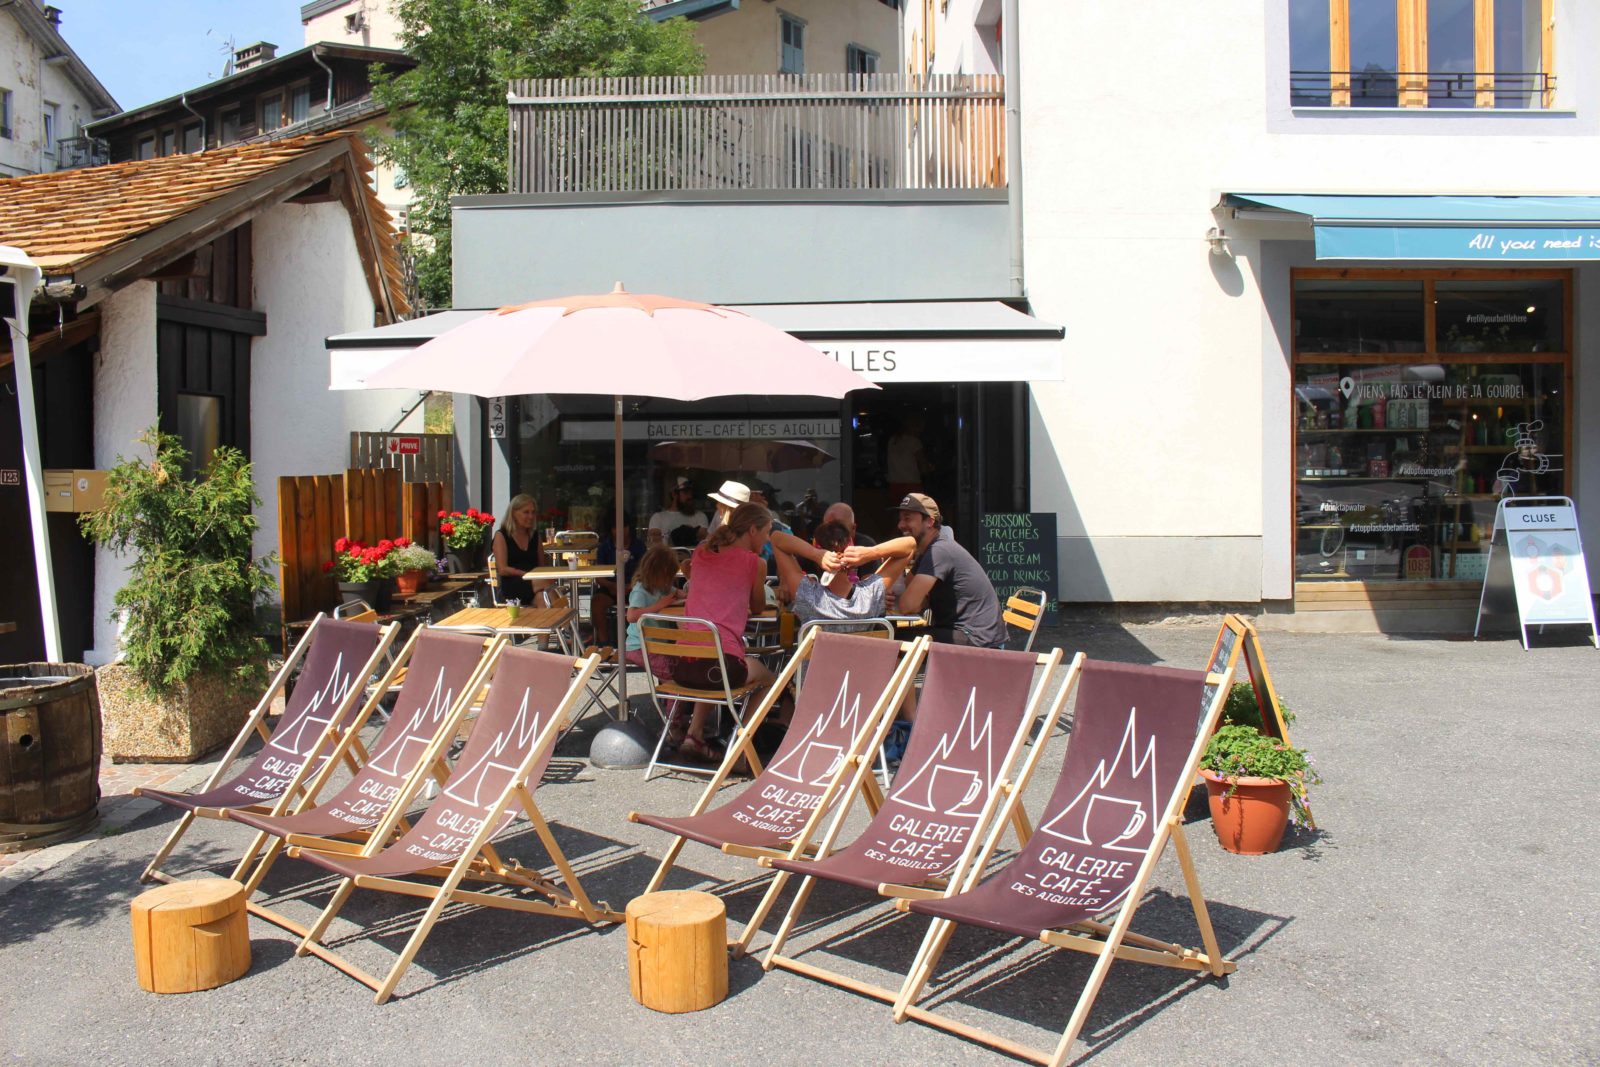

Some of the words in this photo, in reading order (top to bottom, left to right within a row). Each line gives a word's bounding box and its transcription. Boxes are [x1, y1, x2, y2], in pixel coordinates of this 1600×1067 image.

[1468, 233, 1496, 250] All
[1500, 239, 1536, 255] you
[1543, 235, 1583, 249] need
[1466, 314, 1528, 324] #refillyourbottlehere
[1390, 384, 1408, 399] FAIS
[1412, 384, 1424, 399] LE
[1427, 384, 1452, 399] PLEIN
[1456, 384, 1468, 399] DE
[1486, 384, 1525, 399] GOURDE!
[752, 423, 778, 437] DES
[782, 422, 842, 437] AIGUILL
[3, 471, 18, 483] 123
[1320, 502, 1366, 512] #drinktapwater
[984, 513, 1033, 528] BOISSONS
[1522, 513, 1557, 523] CLUSE
[985, 541, 1025, 554] GLACES
[986, 554, 1005, 565] ICE
[1007, 552, 1041, 565] CREAM
[1013, 569, 1051, 583] DRINKS
[261, 756, 302, 778] GALER
[358, 778, 401, 801] GALER
[761, 784, 822, 810] GALERIE
[436, 808, 483, 835] GALER
[732, 811, 752, 823] DES
[748, 820, 796, 833] AIGUILLES
[888, 814, 971, 843] GALERIE
[864, 848, 887, 861] DES
[885, 856, 944, 870] AIGUILLES
[1038, 846, 1134, 879] GALERIE
[1010, 881, 1037, 896] DES
[1036, 890, 1102, 906] AIGUILLES
